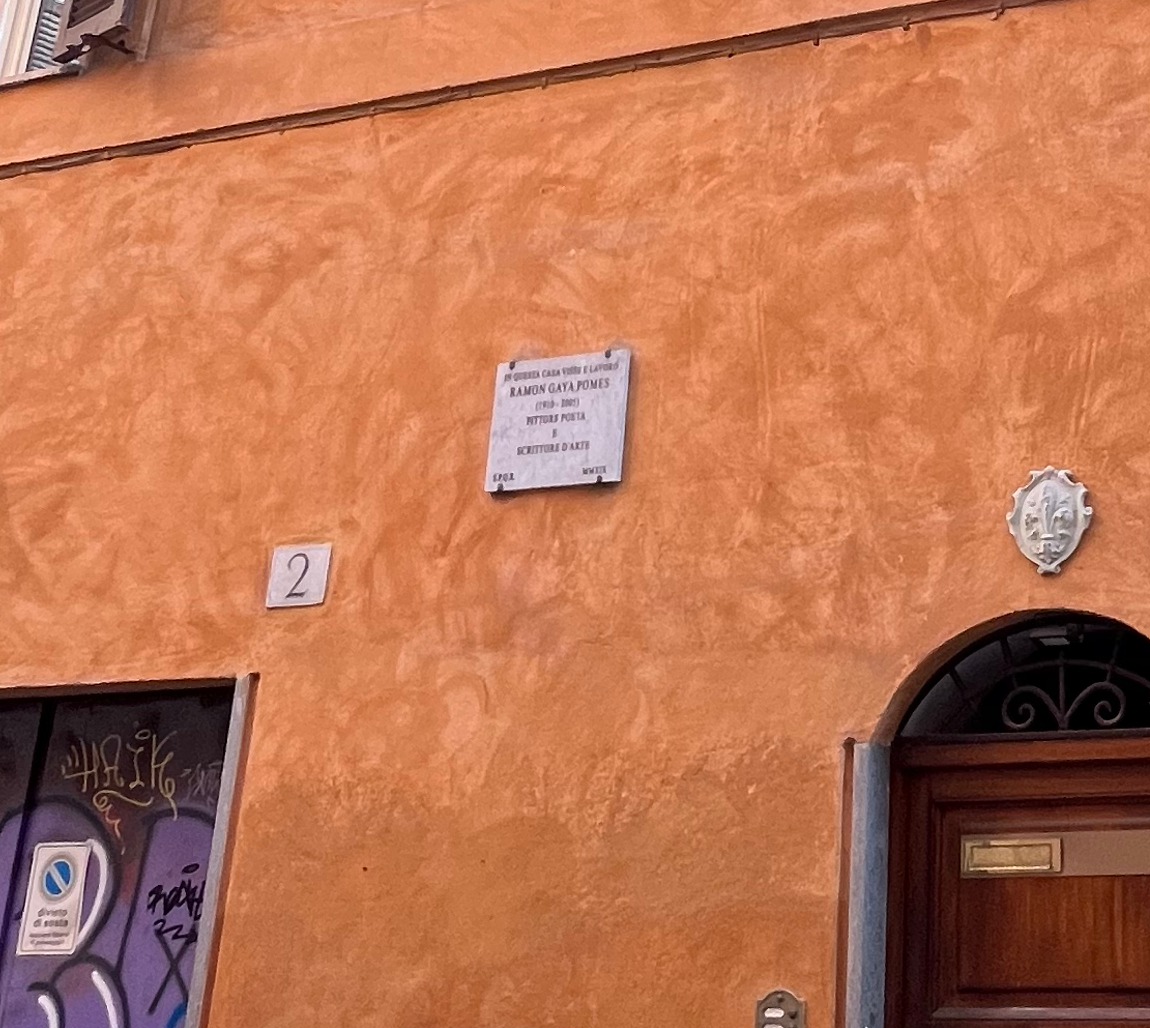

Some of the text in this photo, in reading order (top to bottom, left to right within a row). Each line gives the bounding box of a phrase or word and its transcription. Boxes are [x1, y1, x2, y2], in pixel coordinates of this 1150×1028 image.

[541, 369, 560, 378] CASA
[510, 383, 546, 397] RAMON
[548, 380, 574, 394] GAYA
[552, 428, 558, 438] E
[285, 552, 310, 599] 2
